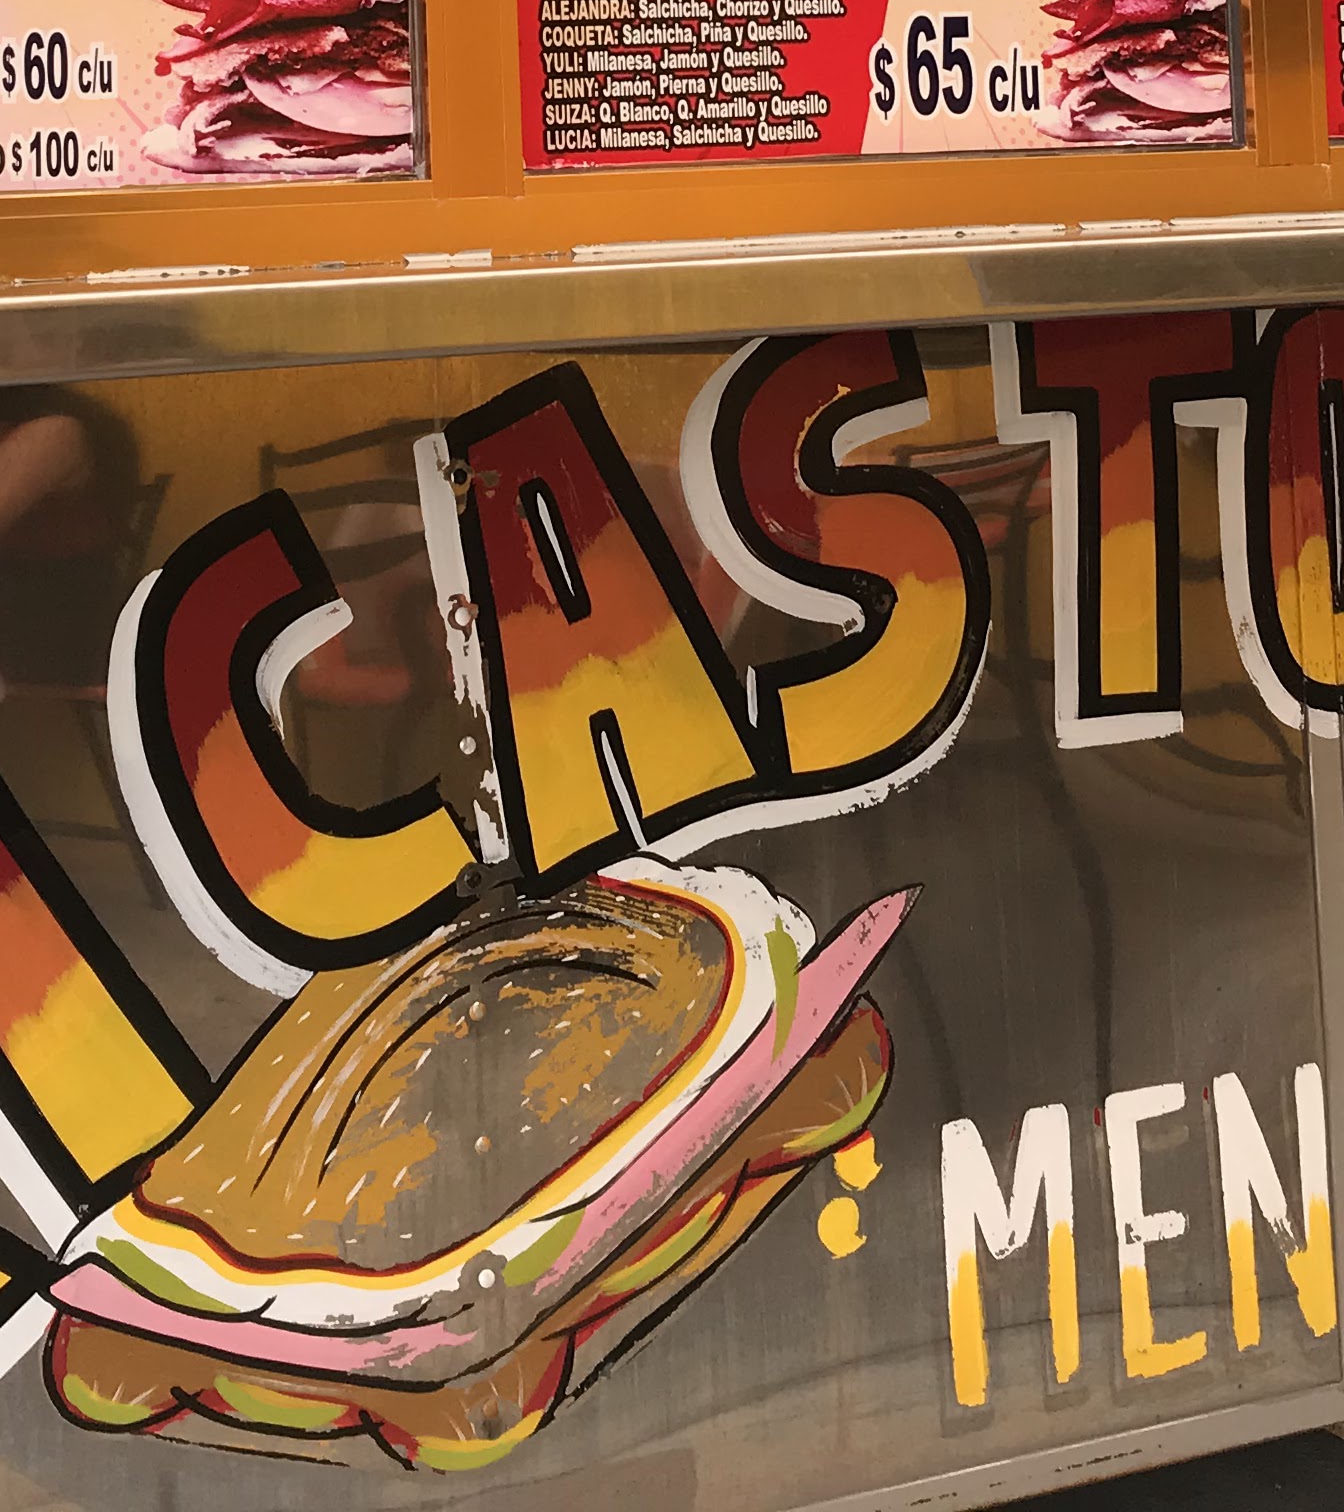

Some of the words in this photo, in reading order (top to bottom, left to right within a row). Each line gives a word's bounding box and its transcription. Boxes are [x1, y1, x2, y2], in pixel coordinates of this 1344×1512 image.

[79, 45, 113, 95] c/u
[989, 48, 1041, 112] c/u
[86, 142, 114, 175] c/u
